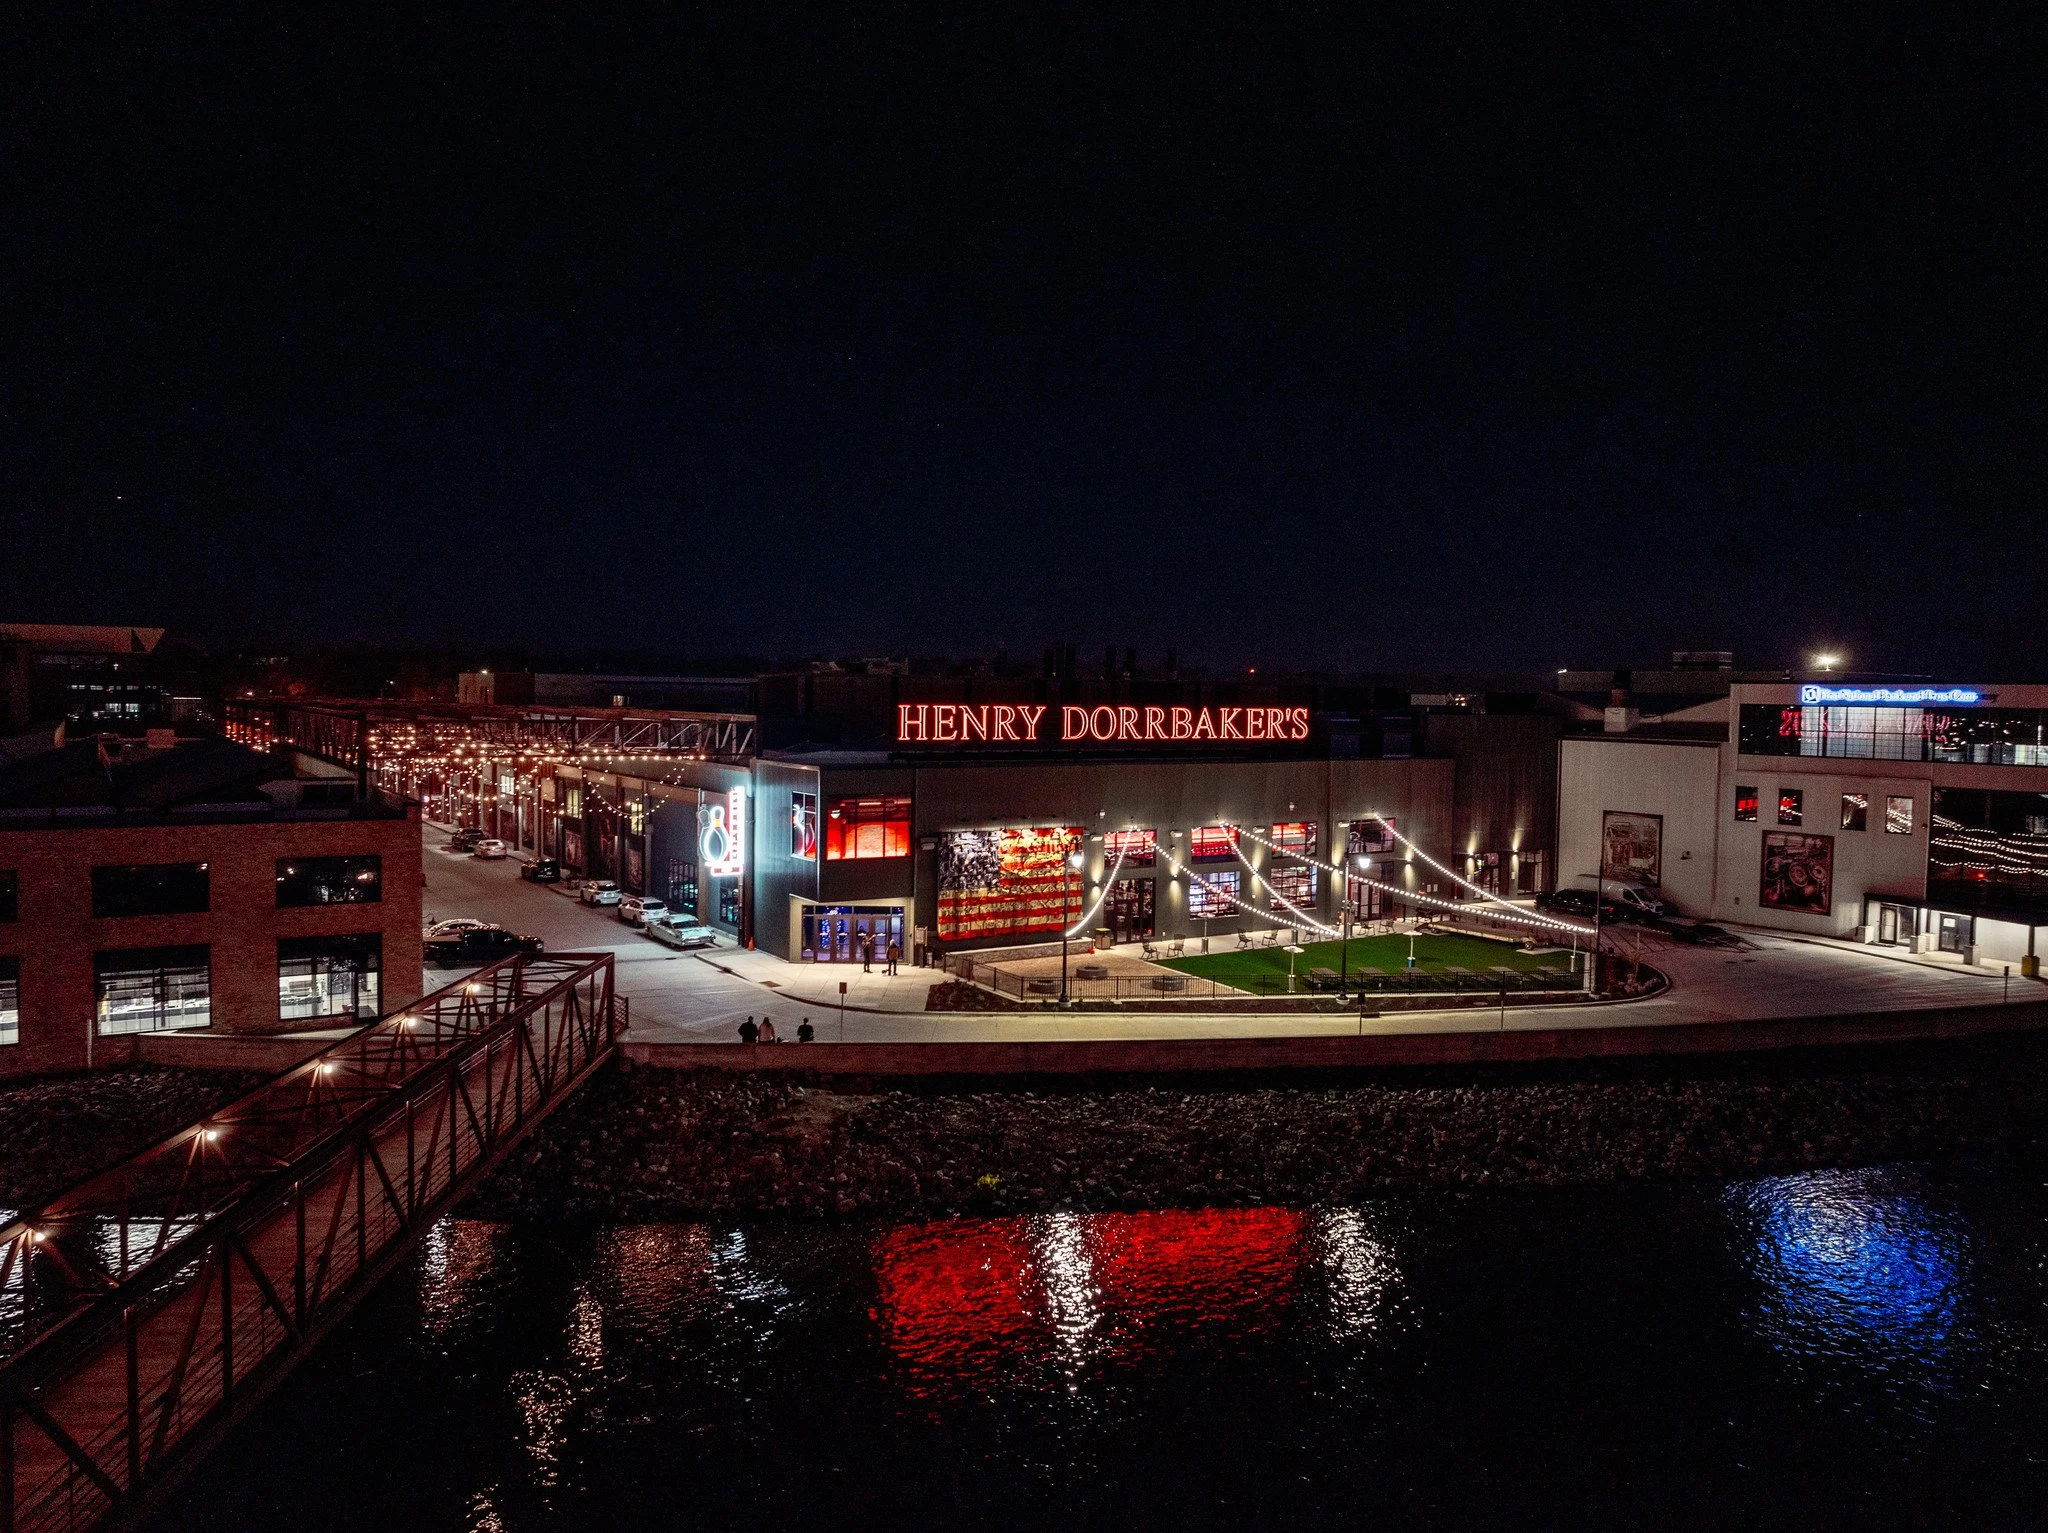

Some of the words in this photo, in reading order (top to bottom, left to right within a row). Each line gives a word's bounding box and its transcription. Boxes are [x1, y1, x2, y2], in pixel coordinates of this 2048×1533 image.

[1841, 690, 1878, 701] National
[1880, 690, 1904, 701] Bank
[898, 705, 1047, 741] HENRY
[1061, 706, 1309, 740] DORRBAKER'S
